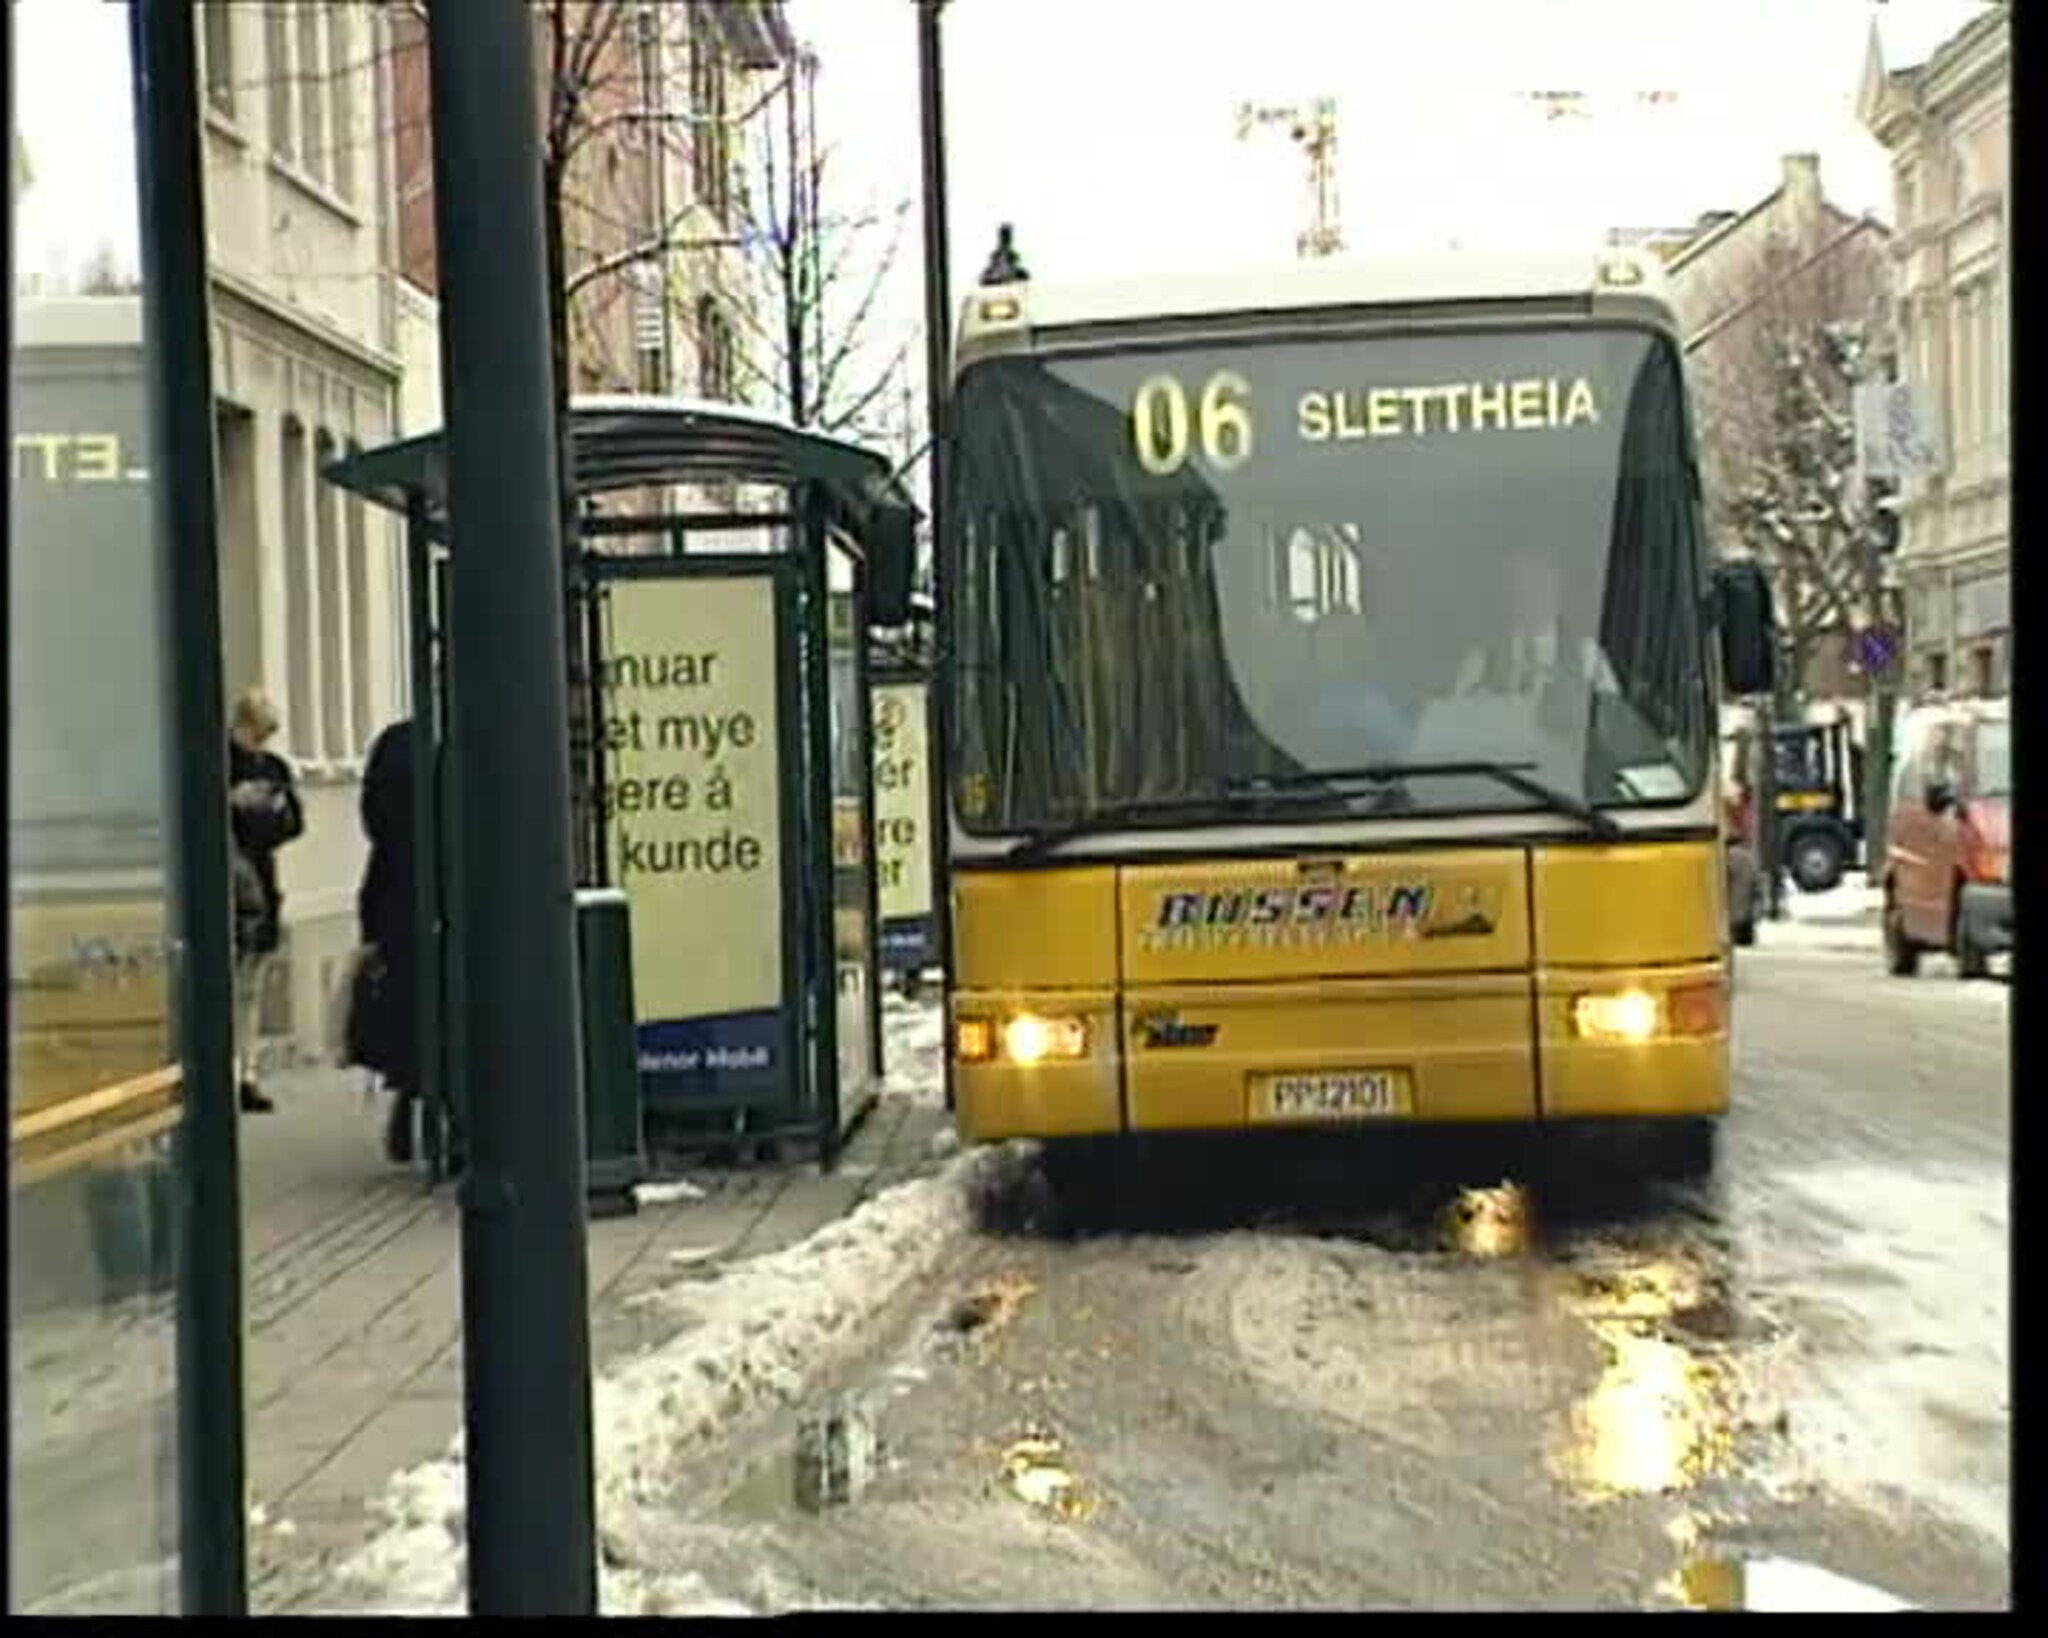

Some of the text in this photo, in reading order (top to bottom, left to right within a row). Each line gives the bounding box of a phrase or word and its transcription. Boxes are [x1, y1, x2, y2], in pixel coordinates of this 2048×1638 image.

[1132, 371, 1600, 475] 06 SLETTHEIA
[658, 713, 755, 759] mye
[705, 763, 733, 812] å
[621, 828, 763, 874] kunde
